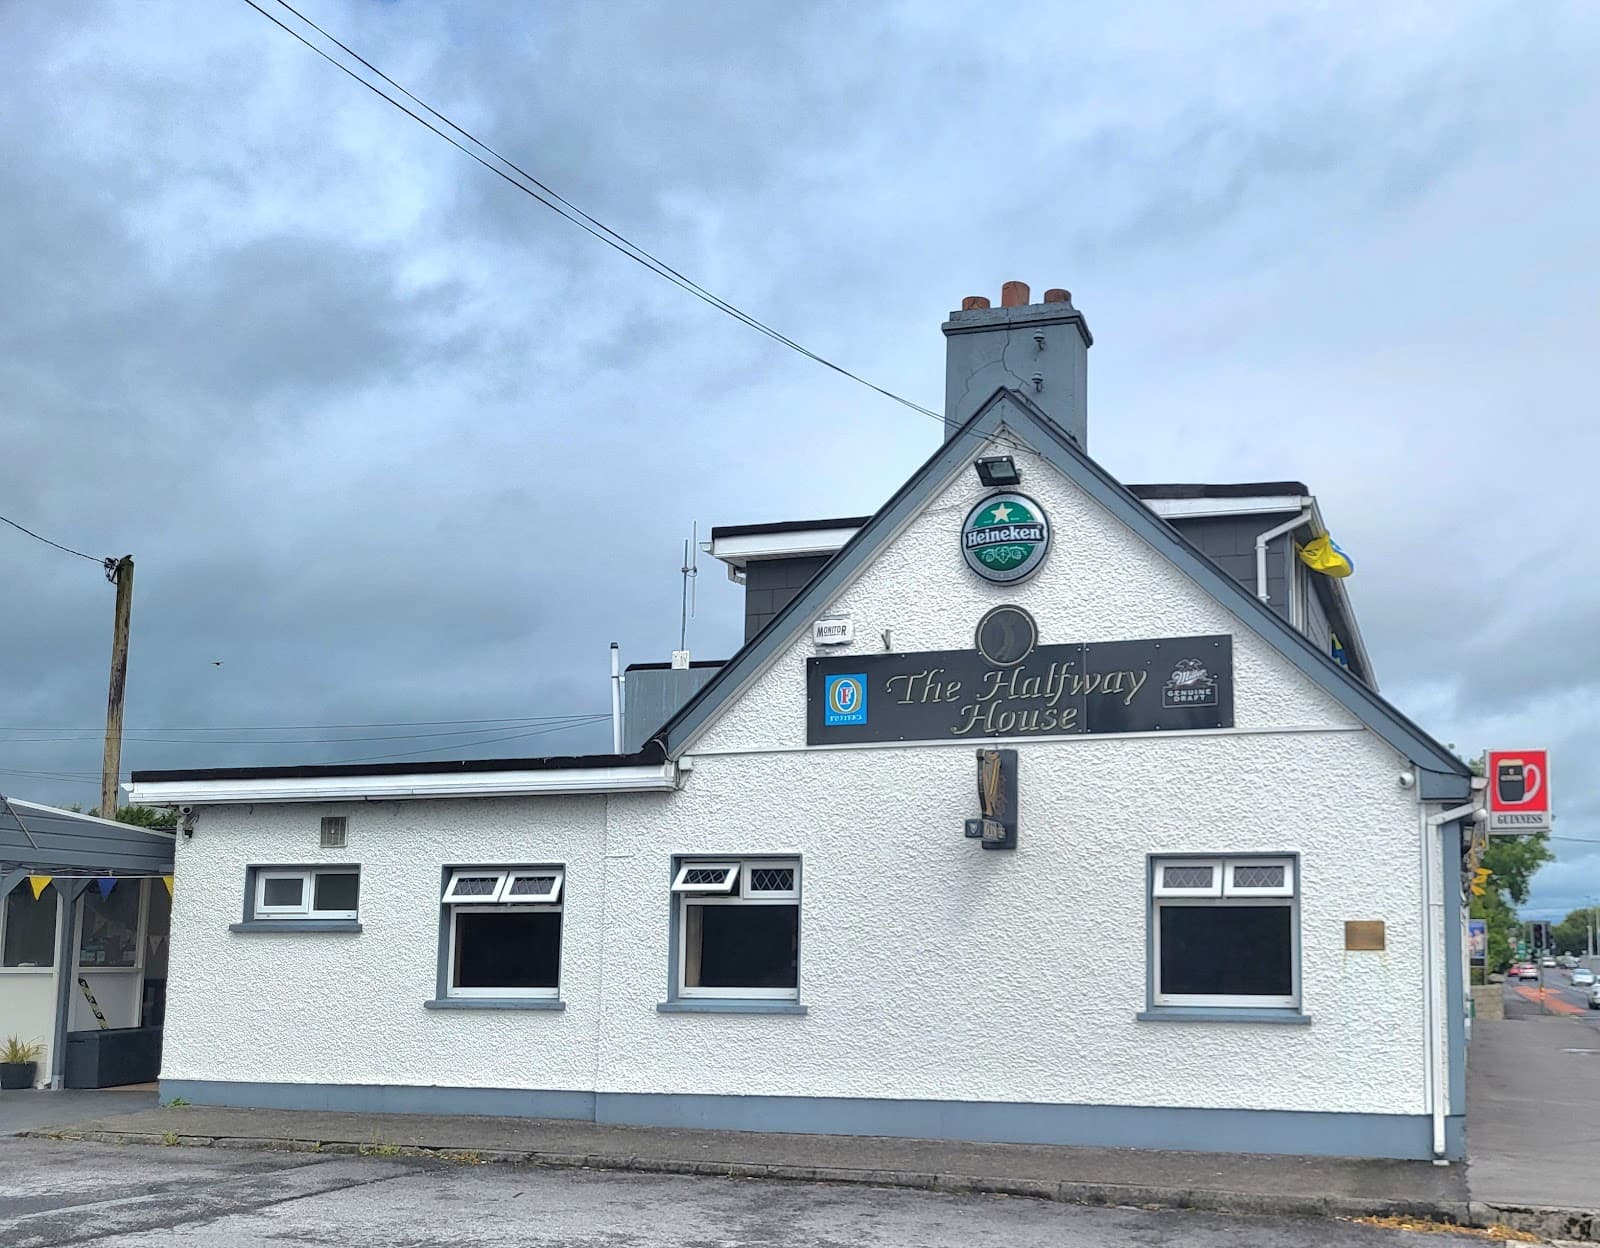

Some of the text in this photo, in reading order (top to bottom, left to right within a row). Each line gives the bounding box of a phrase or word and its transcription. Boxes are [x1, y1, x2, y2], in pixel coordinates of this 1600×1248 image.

[967, 526, 1041, 547] Heineken
[816, 625, 847, 637] MONITOR
[886, 661, 1147, 706] The Halfway
[1167, 688, 1211, 697] GENUINE
[951, 699, 1078, 735] House
[1497, 814, 1544, 824] GUINNESS
